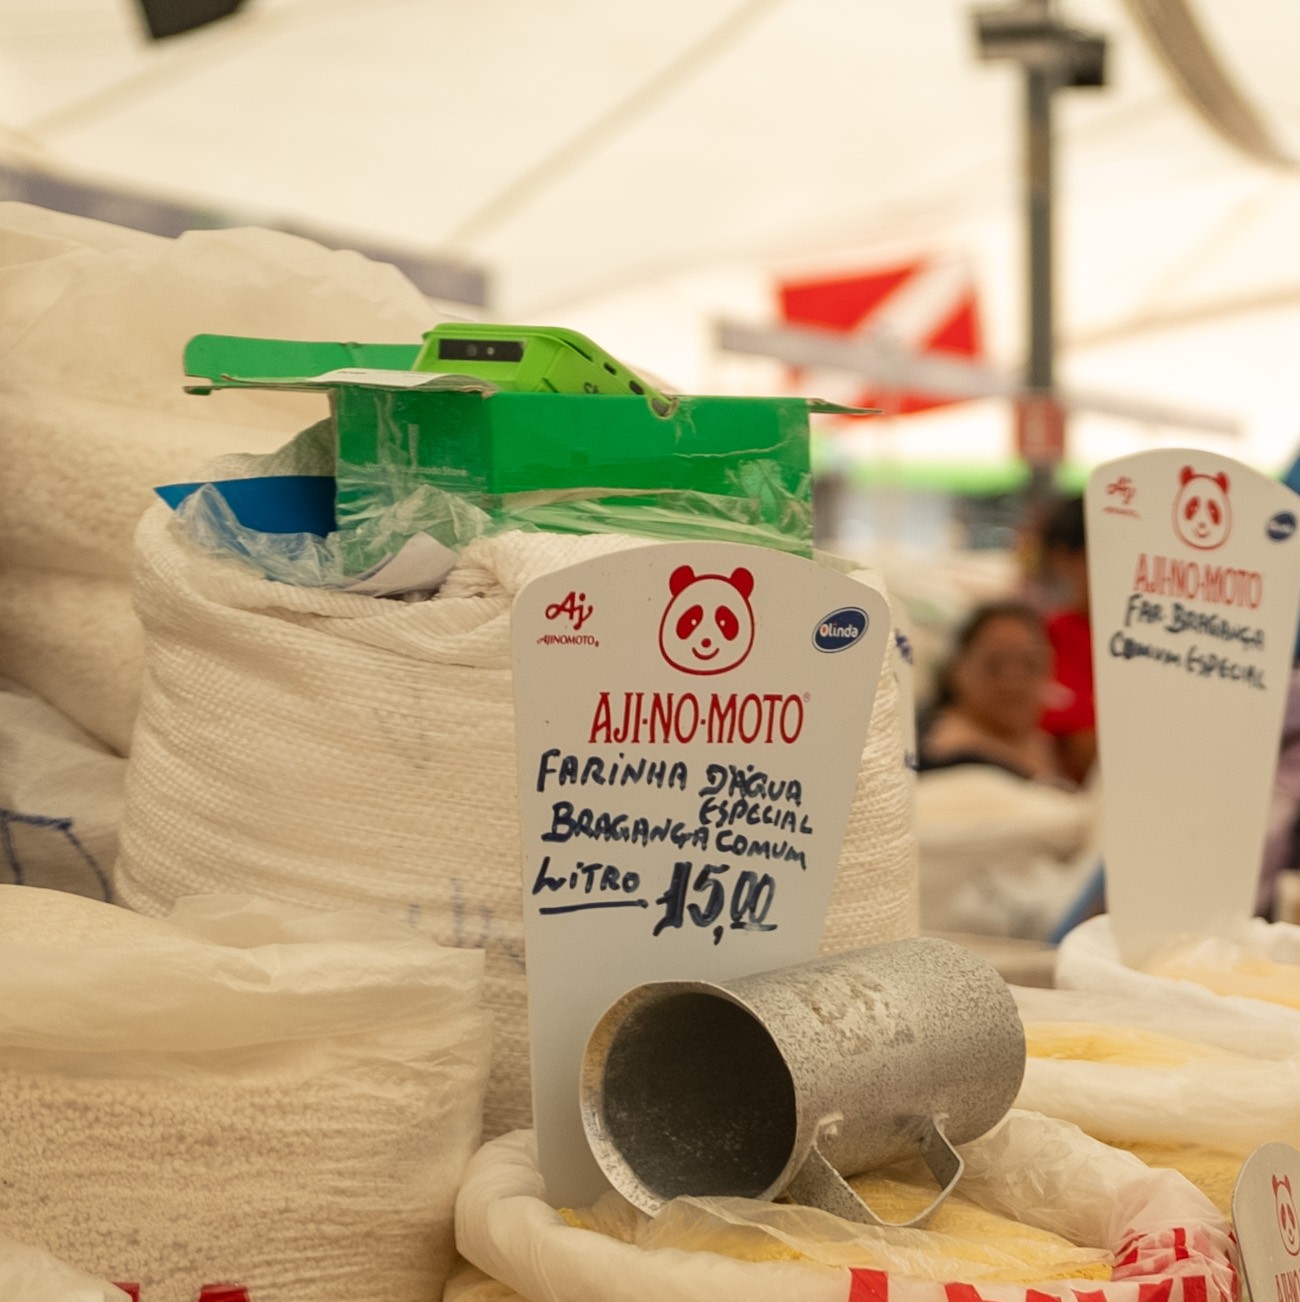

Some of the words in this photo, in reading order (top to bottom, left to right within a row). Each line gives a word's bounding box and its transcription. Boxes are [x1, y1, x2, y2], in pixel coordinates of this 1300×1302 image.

[819, 621, 860, 639] Olinda
[537, 749, 687, 792] FARINHA
[699, 797, 813, 835] ESPECIAL
[715, 829, 807, 871] COMUM
